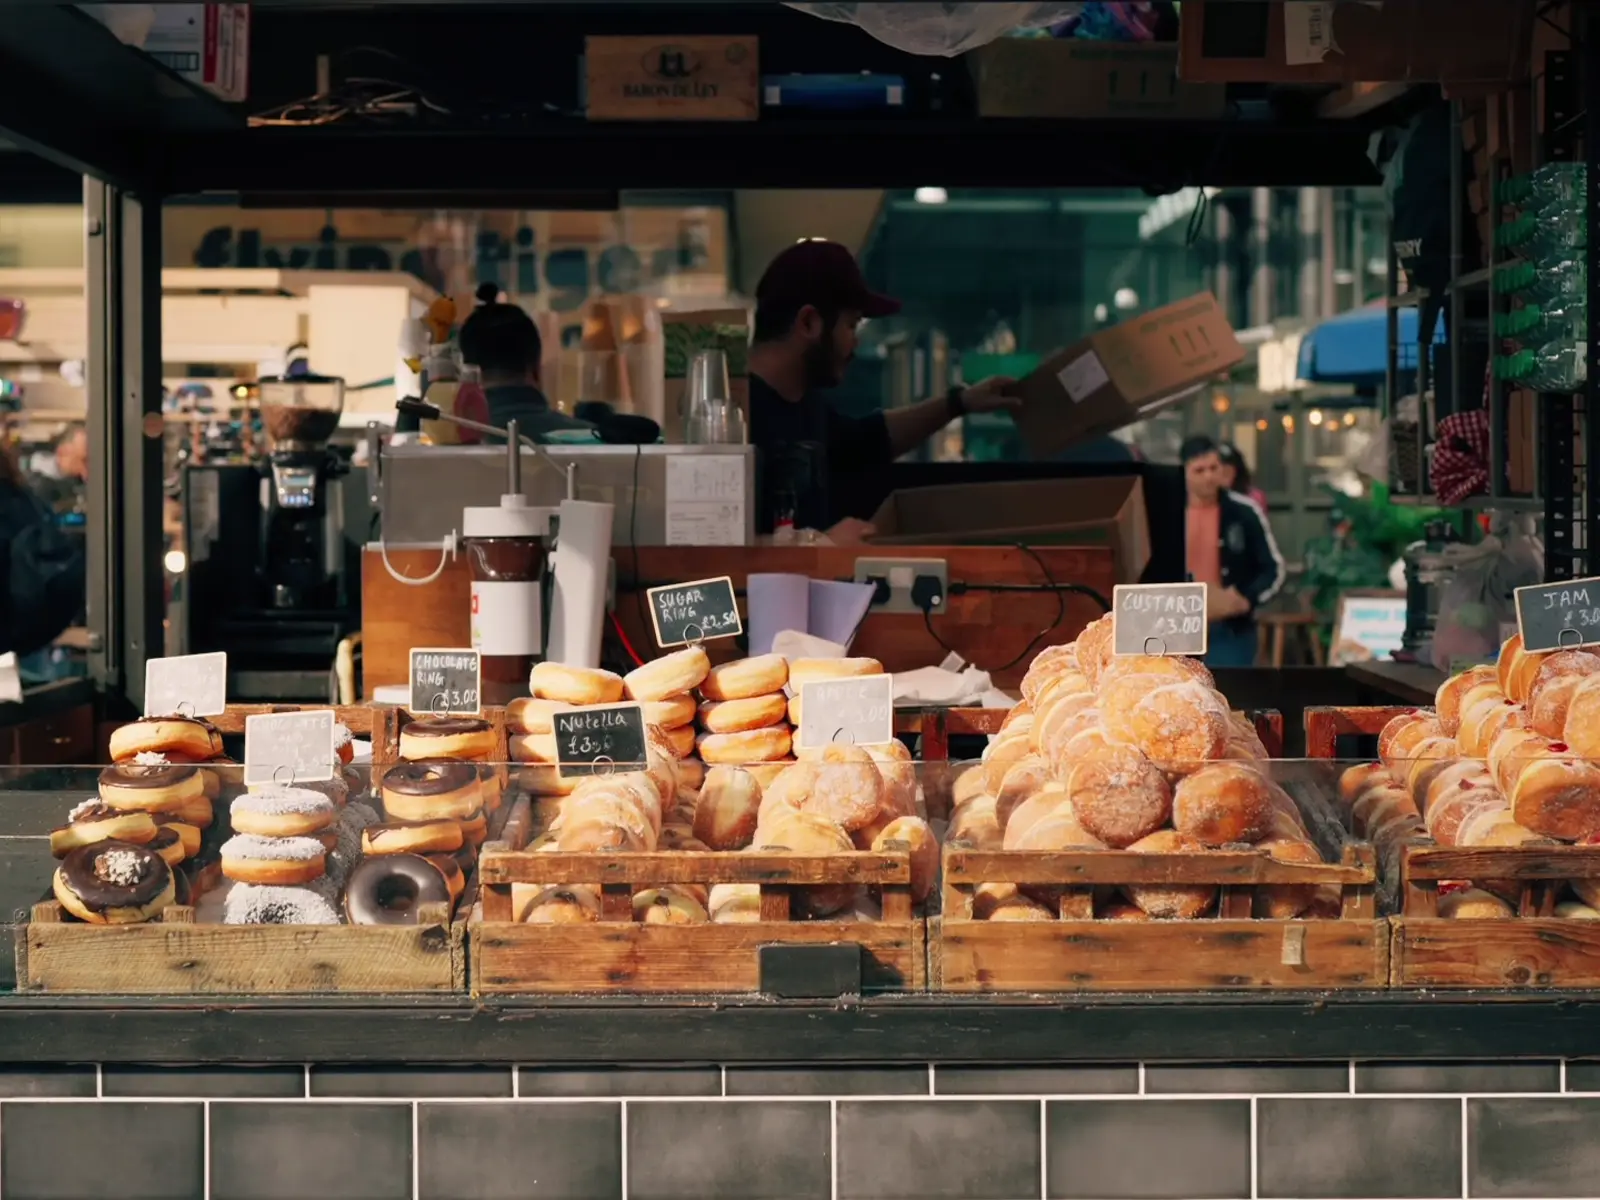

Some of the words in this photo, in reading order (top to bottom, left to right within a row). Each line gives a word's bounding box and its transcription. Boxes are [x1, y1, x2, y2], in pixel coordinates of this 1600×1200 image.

[658, 590, 704, 609] SUGAR
[1122, 592, 1204, 614] CUSTARD
[1543, 588, 1591, 610] JAM
[663, 606, 697, 623] RING
[702, 610, 737, 630] £2.50
[415, 654, 478, 671] CHOCOLATE
[416, 671, 446, 688] RING
[440, 689, 478, 707] £3.00
[559, 712, 628, 732] Nutella
